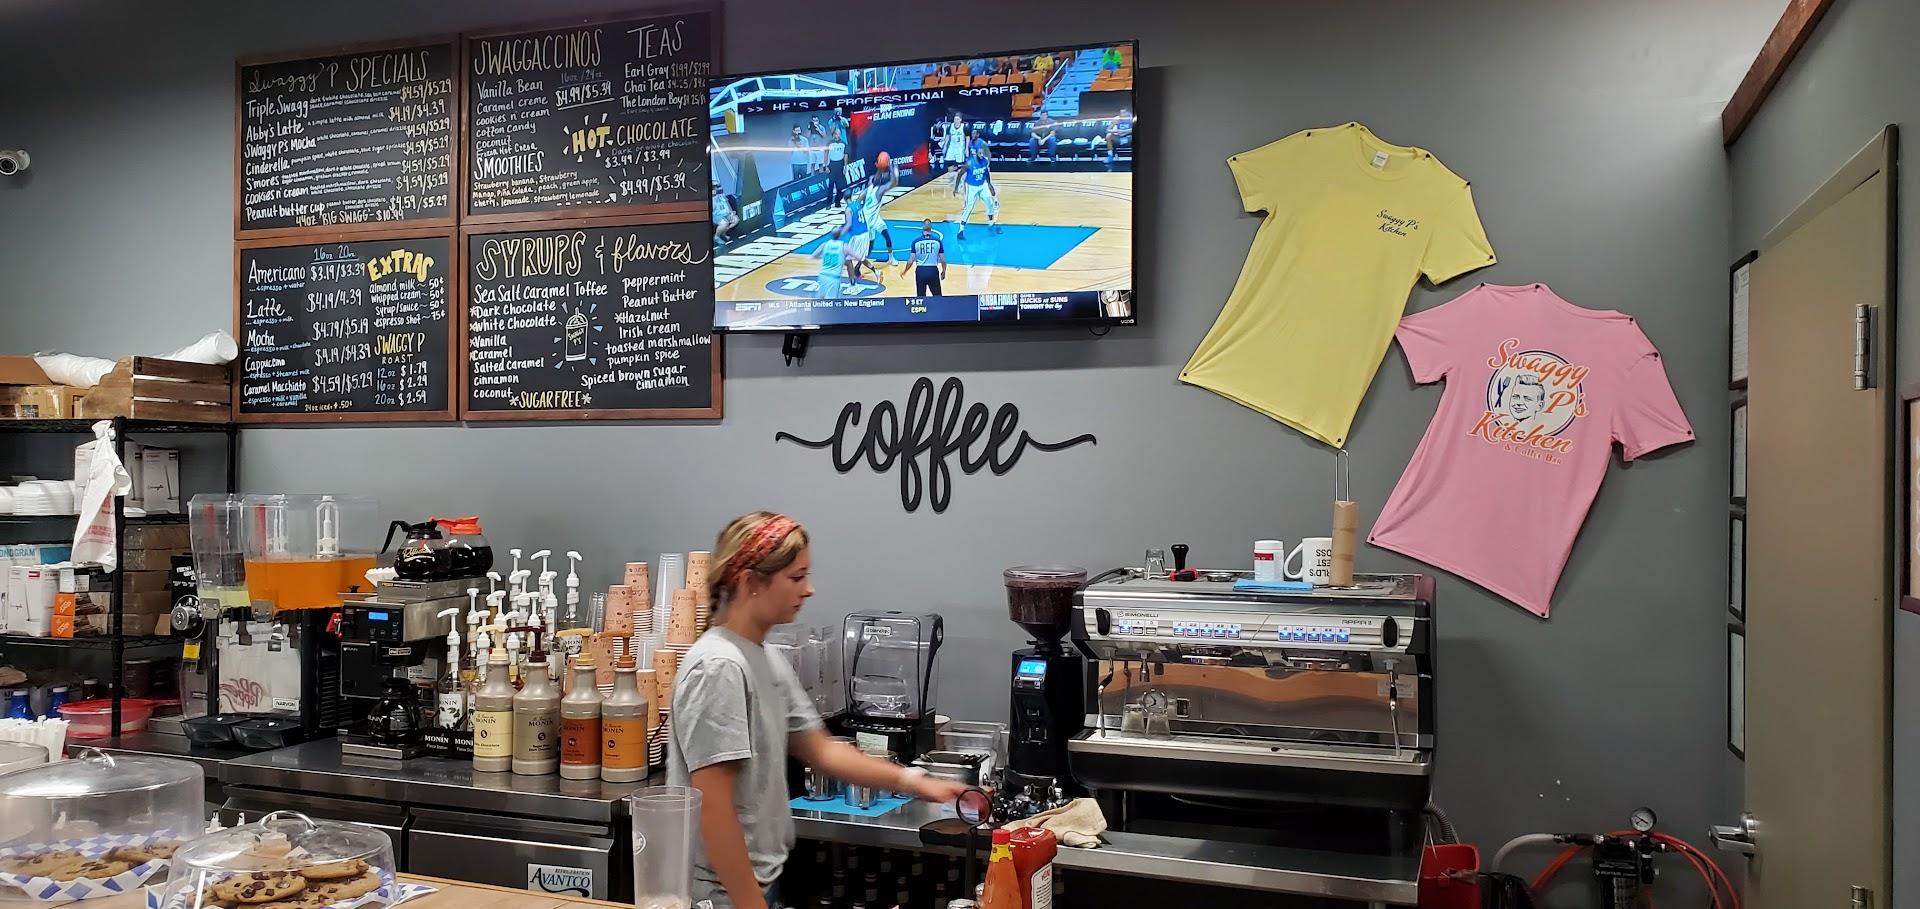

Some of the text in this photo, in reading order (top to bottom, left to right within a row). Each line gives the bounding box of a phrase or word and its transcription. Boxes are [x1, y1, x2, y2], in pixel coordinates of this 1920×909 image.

[626, 20, 686, 60] TEAS
[474, 29, 603, 76] SWAGGACCINOS
[346, 51, 430, 92] SPECIALS
[625, 63, 645, 79] Earl
[647, 63, 669, 79] Gray
[401, 79, 452, 103] $4.59/$5.29
[477, 78, 544, 100] Vanilla Bean
[555, 80, 613, 107] $4.99/$5.39
[624, 80, 647, 94] Chai
[648, 79, 666, 92] Tea
[246, 97, 275, 124] Triple
[276, 95, 309, 118] Swagg
[476, 95, 549, 116] Caramel creme
[620, 95, 637, 108] The
[638, 95, 667, 107] London
[667, 91, 683, 110] Boy
[388, 99, 446, 123] $4.19/$4.39
[476, 108, 551, 127] cookies cream
[246, 119, 304, 143] Abby's Latte
[405, 117, 451, 139] $4.59/$5.29
[476, 121, 537, 138] cotton Candy
[572, 117, 698, 154] HOT CHOCOLATE
[244, 136, 317, 161] Swaggy P's Mocha
[403, 135, 450, 157] $4.59/$5.29
[246, 157, 291, 176] Cinderella
[400, 155, 450, 175] $4.59/$5.29
[473, 151, 545, 180] SMOOTHIES
[605, 149, 671, 169] $3.49 $3.99
[246, 175, 280, 191] S'mores
[396, 172, 449, 195] $4.59/$5.29
[474, 181, 510, 192] Strawberry
[539, 171, 578, 183] Strawberry
[561, 180, 580, 190] green
[620, 173, 687, 198] $4.99/$5.39
[245, 189, 275, 206] cookies
[284, 187, 309, 199] cream
[388, 194, 448, 213] $4.59/$5.29
[534, 190, 568, 203] strawberry
[569, 187, 600, 200] lemonade
[246, 205, 278, 222] Peanut
[279, 203, 308, 218] butter
[309, 202, 326, 217] cup
[376, 209, 405, 221] $10.99
[1377, 209, 1420, 230] Swaggy P's
[1378, 222, 1407, 237] Kitchen
[313, 245, 356, 261] 16oz 20oz
[476, 231, 587, 281] SYRUPS
[611, 233, 710, 274] flavors
[920, 242, 936, 254] REF
[248, 259, 366, 285] Americano $3.19/$3.39
[367, 249, 435, 283] EXTRAS
[369, 279, 416, 294] almond milk
[371, 287, 445, 304] whipped cream 50¢
[474, 280, 609, 304] Sea Salt Caramel Toffee
[246, 288, 362, 319] Latte $4.19/4.39
[503, 299, 557, 316] Chocolate
[622, 289, 699, 309] Peanut Butter
[735, 303, 761, 311] ESPN
[789, 301, 811, 310] Atlanta
[859, 299, 885, 308] England
[312, 318, 369, 342] $4.79/$5.19
[374, 317, 405, 328] espresso
[406, 313, 422, 325] shot
[507, 314, 557, 330] Chocolate
[246, 329, 275, 347] Mocha
[619, 325, 644, 340] Irish
[374, 332, 426, 356] SWAGGY P
[605, 334, 712, 355] toasted marshmallow
[315, 343, 372, 367] $4.19/$4.39
[381, 353, 414, 365] ROAST
[606, 350, 681, 370] pumpkin spice
[1487, 338, 1590, 390] Swaggy
[377, 367, 396, 379] 12oz
[473, 358, 506, 374] Salted
[243, 371, 373, 397] Caramel Macchiato $4.59/$5.29
[376, 379, 396, 391] 16oz
[473, 373, 520, 387] cinnamon
[581, 364, 687, 390] Spiced brown sugar
[635, 375, 690, 391] cinnamon
[375, 393, 396, 405] 20oz
[473, 387, 513, 399] coconut
[1542, 391, 1588, 416] P's
[1468, 411, 1571, 453] Kitchen
[775, 377, 1096, 512] coffee
[1315, 549, 1332, 557] OSS
[1316, 559, 1331, 567] EST
[530, 867, 590, 889] AVANTCO
